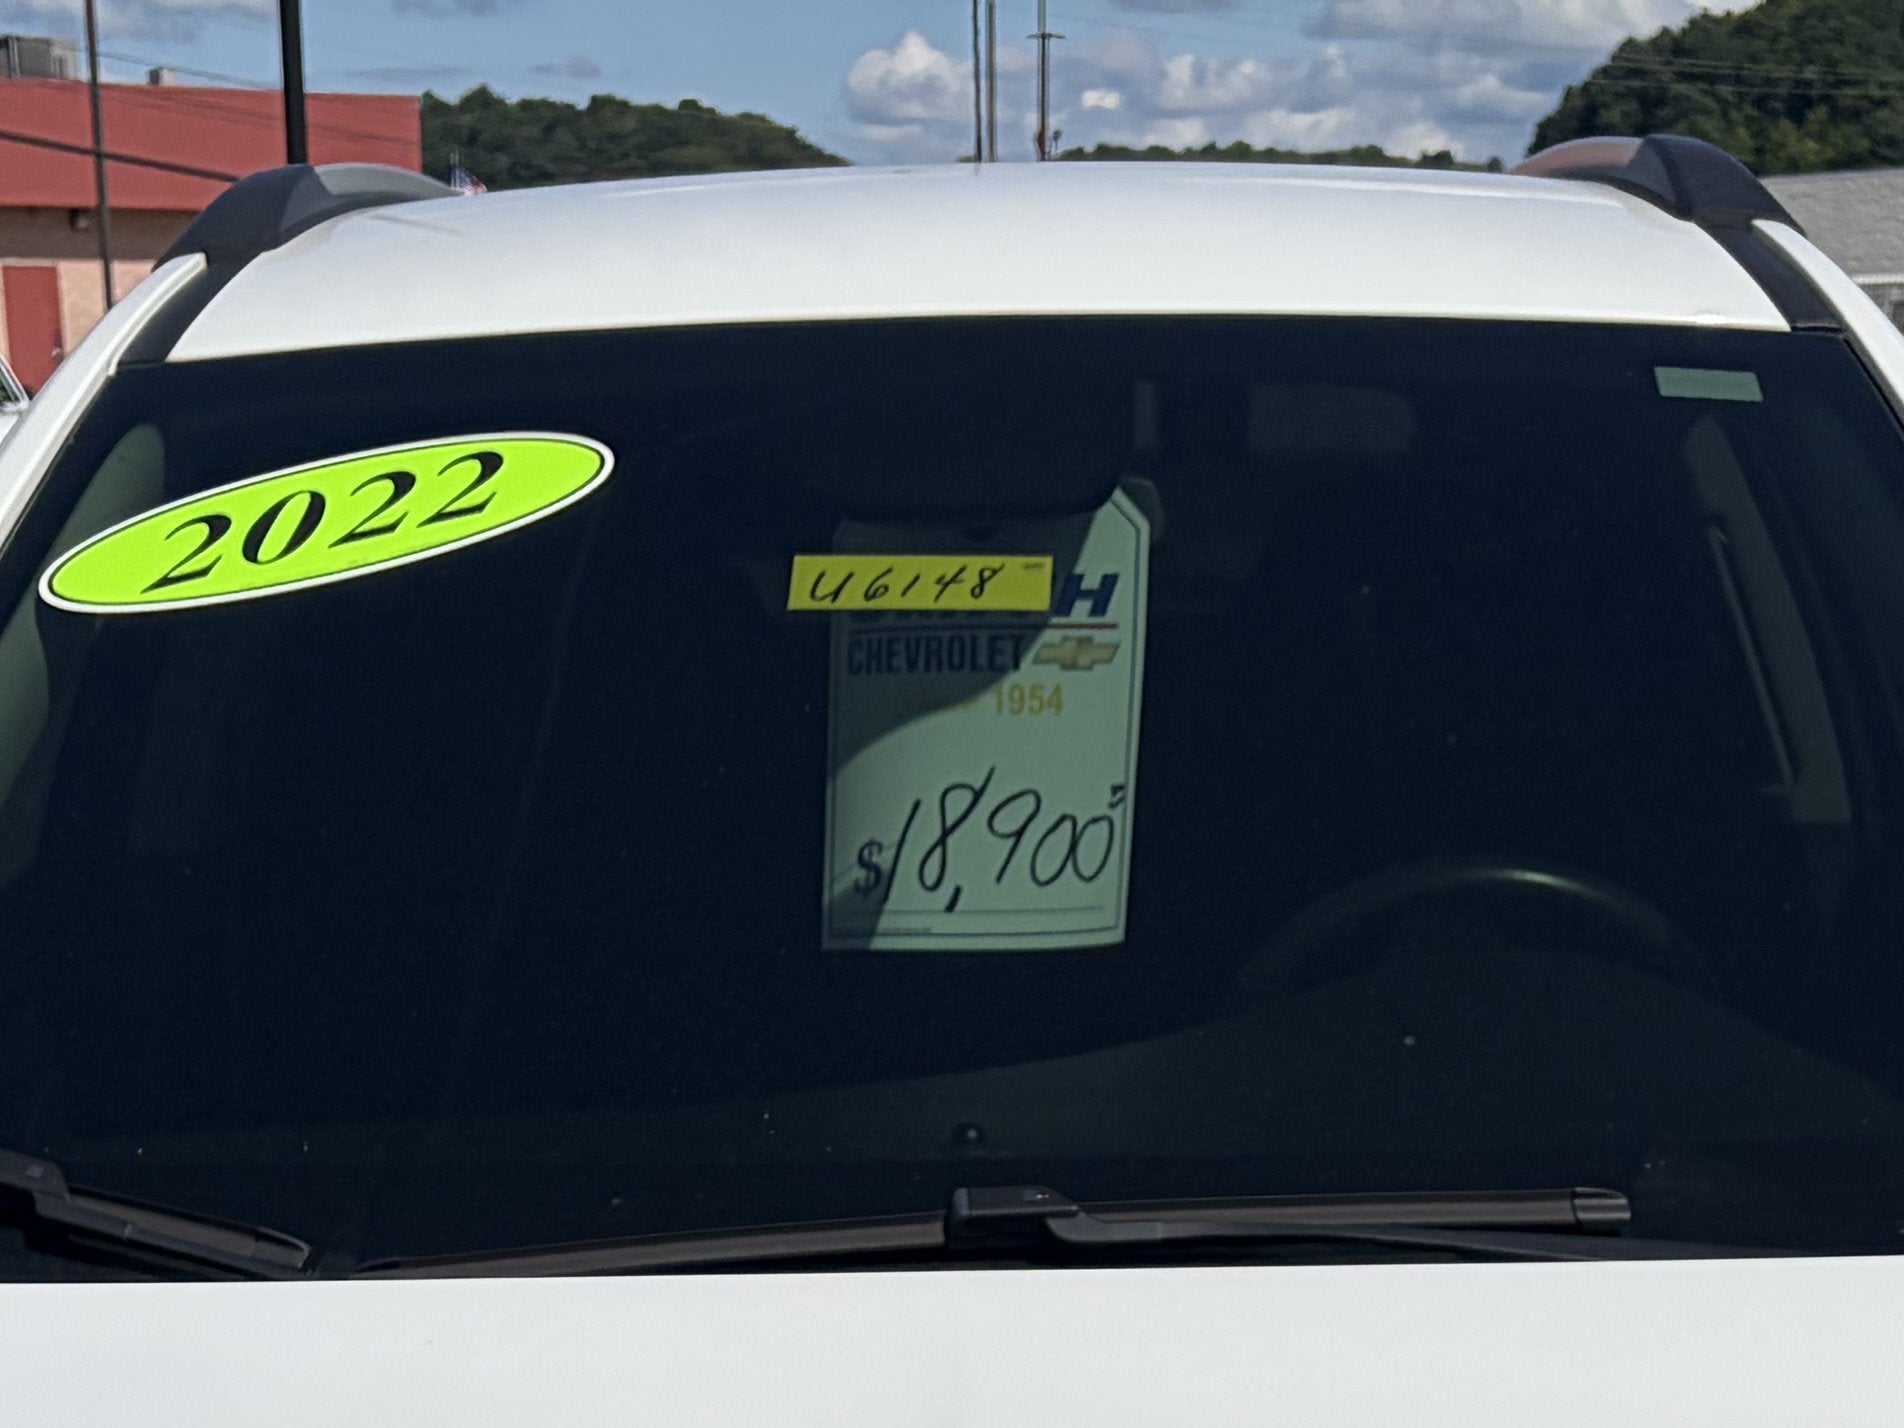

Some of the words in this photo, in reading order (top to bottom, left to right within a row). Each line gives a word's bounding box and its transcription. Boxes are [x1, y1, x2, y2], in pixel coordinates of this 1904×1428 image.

[140, 451, 504, 594] 2022
[849, 635, 1023, 674] CHEVROLET
[996, 684, 1063, 717] 1954
